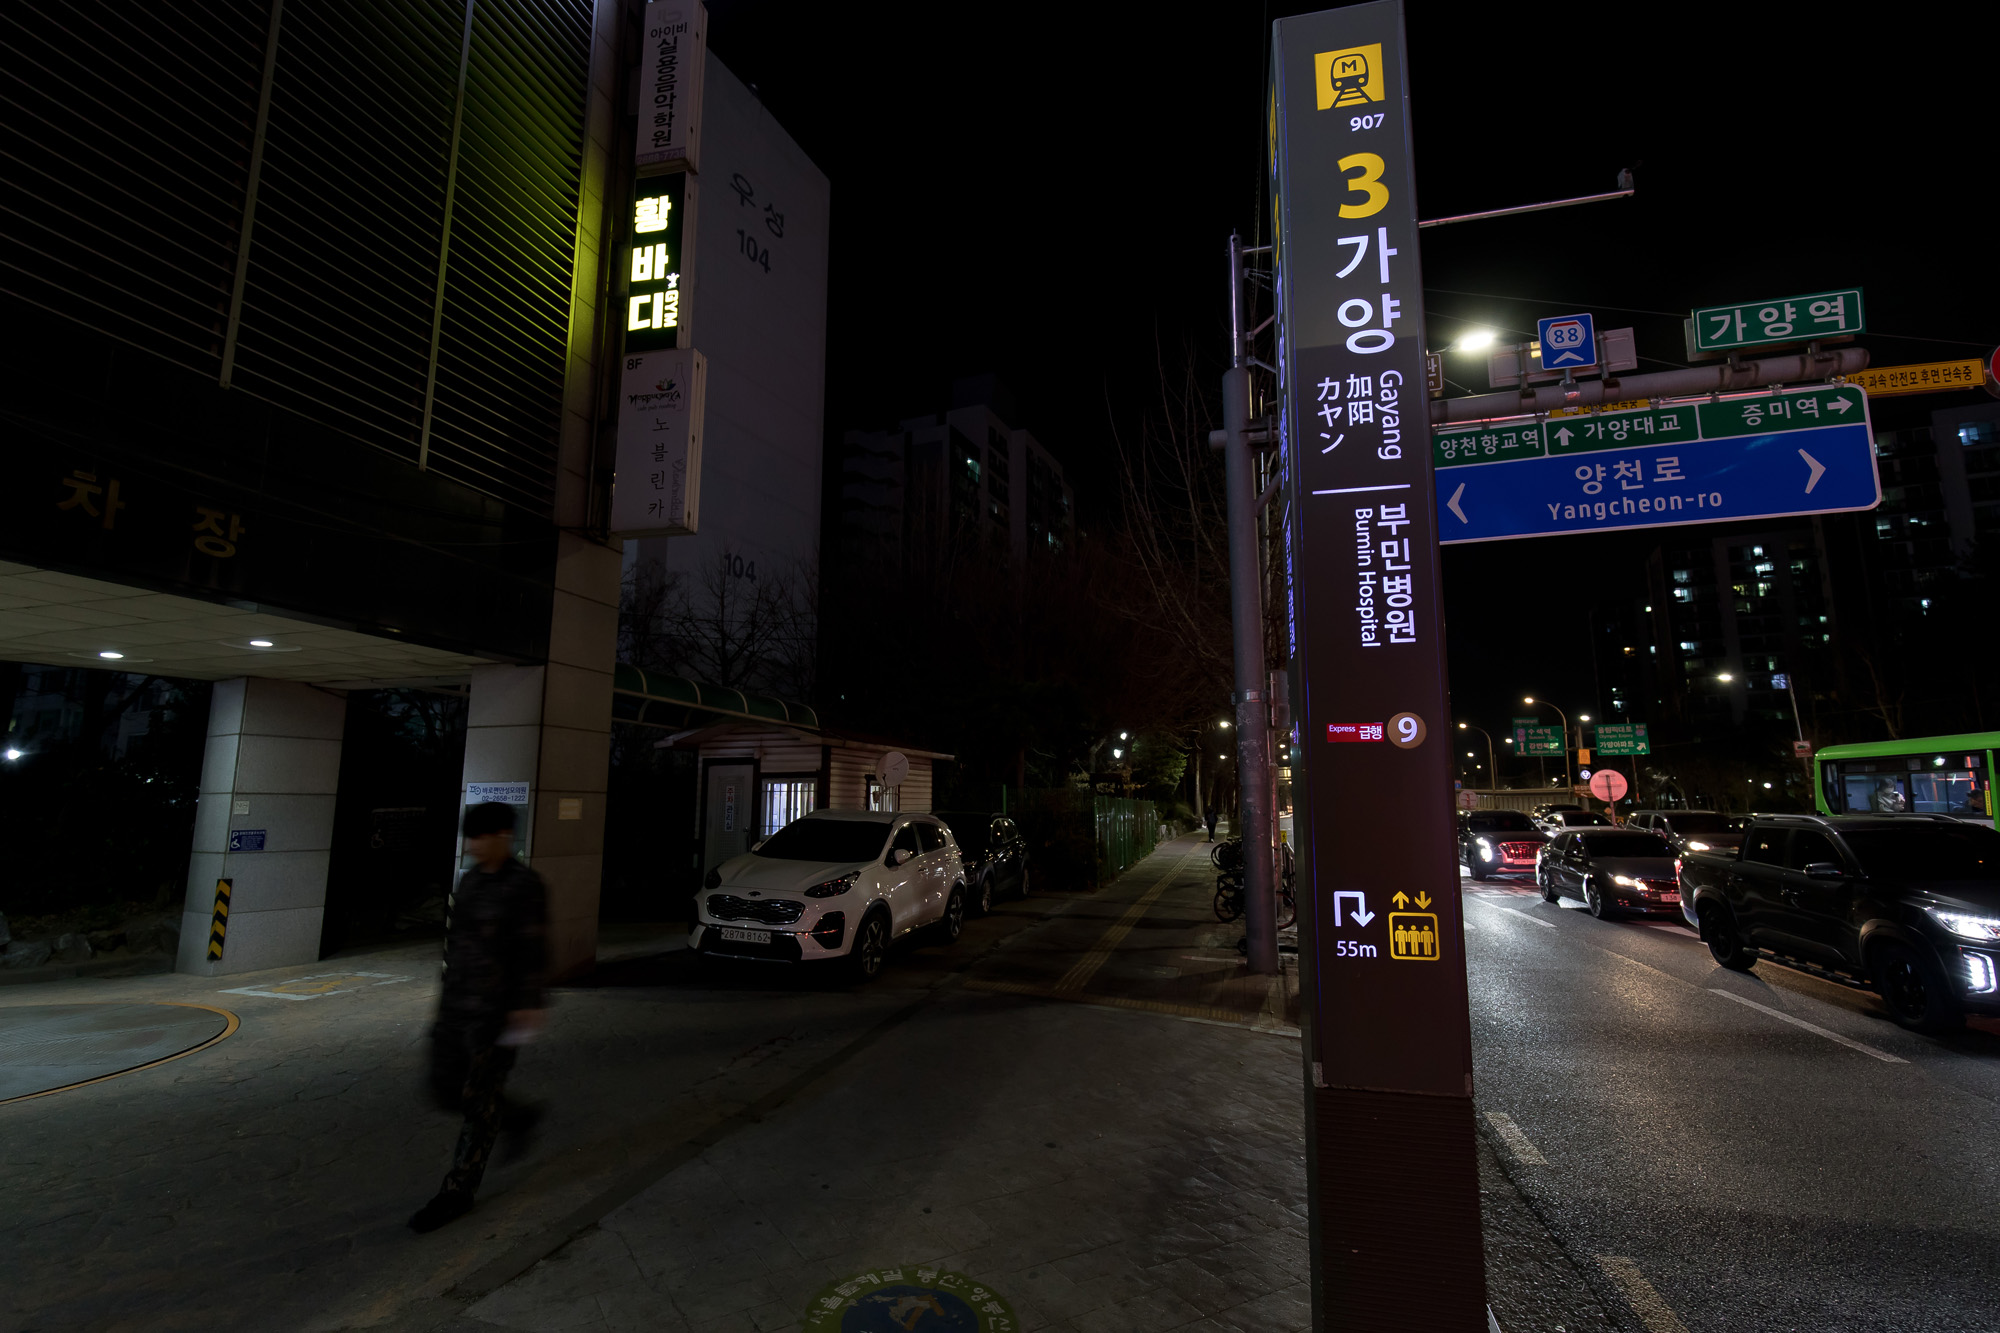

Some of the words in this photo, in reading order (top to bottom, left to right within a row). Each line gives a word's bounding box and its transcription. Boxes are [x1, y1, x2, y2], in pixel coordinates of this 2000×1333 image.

[650, 22, 687, 39] 아이비
[652, 36, 679, 148] 실용음악학원
[1350, 113, 1385, 132] 907
[1337, 151, 1390, 219] 3
[627, 194, 672, 332] 황바디
[736, 228, 771, 274] 104
[663, 289, 680, 328] GYM
[1335, 227, 1402, 355] 가양
[1553, 327, 1579, 344] 88
[1709, 296, 1846, 342] 가양역
[626, 358, 643, 370] 8F
[1889, 371, 1919, 388] 안전모
[1920, 367, 1940, 384] 후면
[1942, 365, 1972, 383] 단속중
[1317, 377, 1344, 455] カヤン
[1346, 373, 1374, 426] 加阳
[1377, 369, 1403, 460] Gayang
[1741, 397, 1819, 426] 증미역
[1440, 429, 1539, 459] 양천향교역
[1584, 414, 1681, 440] 가양대교
[648, 417, 669, 519] 노블린카
[1575, 456, 1686, 495] 양천로
[1547, 491, 1723, 521] Yangcheon-ro
[1355, 507, 1375, 567] Bumin
[724, 552, 757, 584] 104
[1377, 503, 1416, 645] 부민병원
[1355, 571, 1381, 647] Hospital
[1328, 724, 1356, 734] Express
[1358, 724, 1383, 740] 급행
[1397, 717, 1417, 742] 9
[746, 931, 768, 943] 8162
[1336, 940, 1377, 958] 55m
